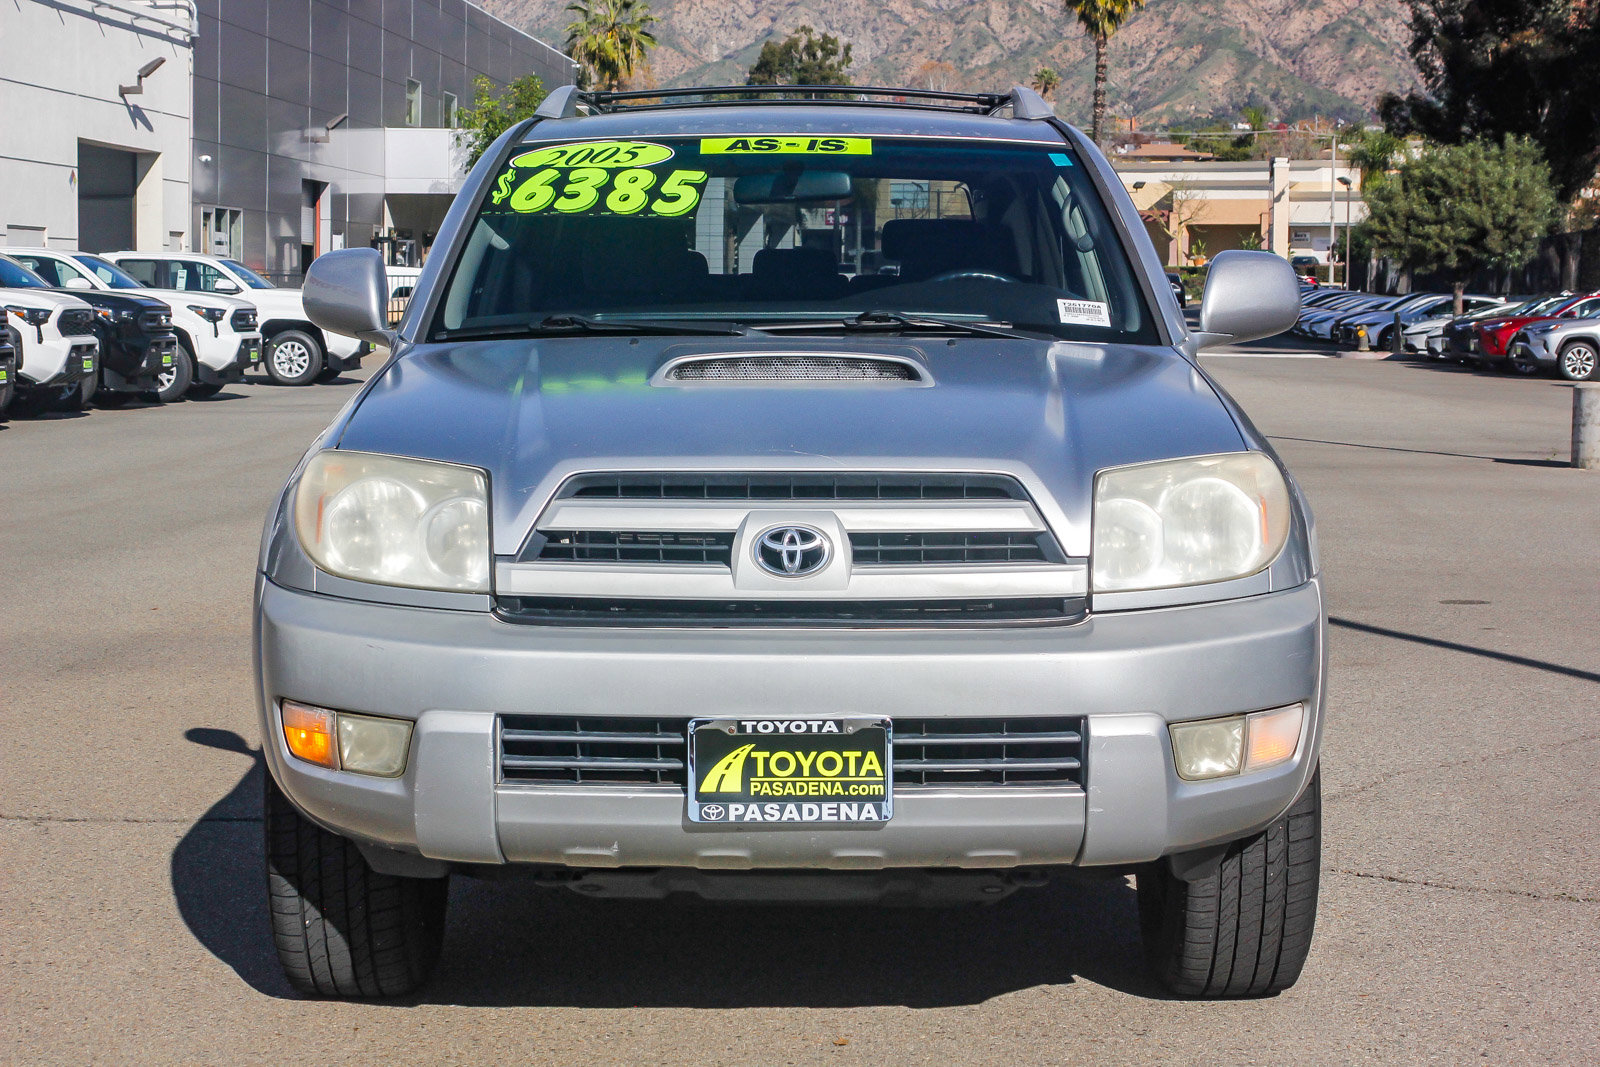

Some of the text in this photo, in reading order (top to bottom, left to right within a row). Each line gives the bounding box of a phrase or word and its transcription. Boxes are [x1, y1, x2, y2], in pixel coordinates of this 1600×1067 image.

[543, 146, 647, 167] 2005
[491, 167, 708, 217] $6385
[741, 720, 839, 733] TOYOTA
[751, 750, 884, 777] TOYOTA
[750, 781, 884, 796] PASADENA.com
[729, 803, 879, 821] PASADENA
